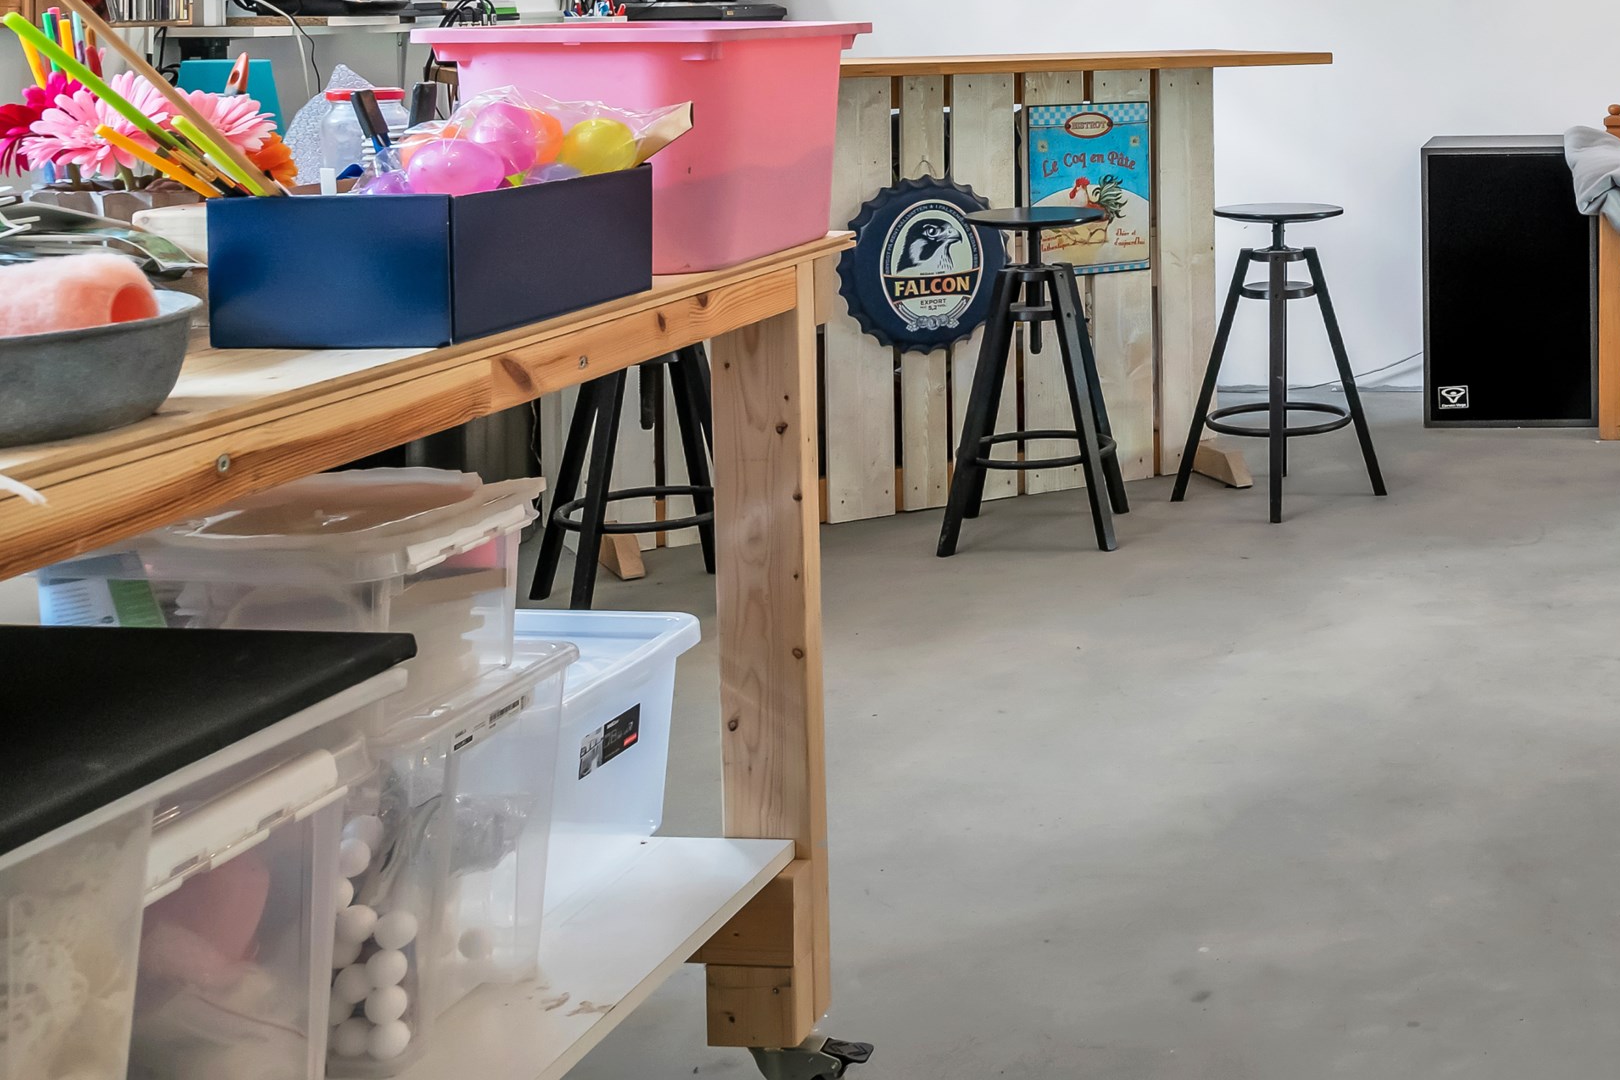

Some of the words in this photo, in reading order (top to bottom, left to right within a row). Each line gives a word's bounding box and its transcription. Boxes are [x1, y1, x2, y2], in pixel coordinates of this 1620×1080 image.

[1042, 159, 1058, 178] Le
[1063, 152, 1087, 168] Coq
[1089, 153, 1105, 163] en
[1107, 150, 1136, 171] Pâte
[894, 275, 970, 297] FALCON
